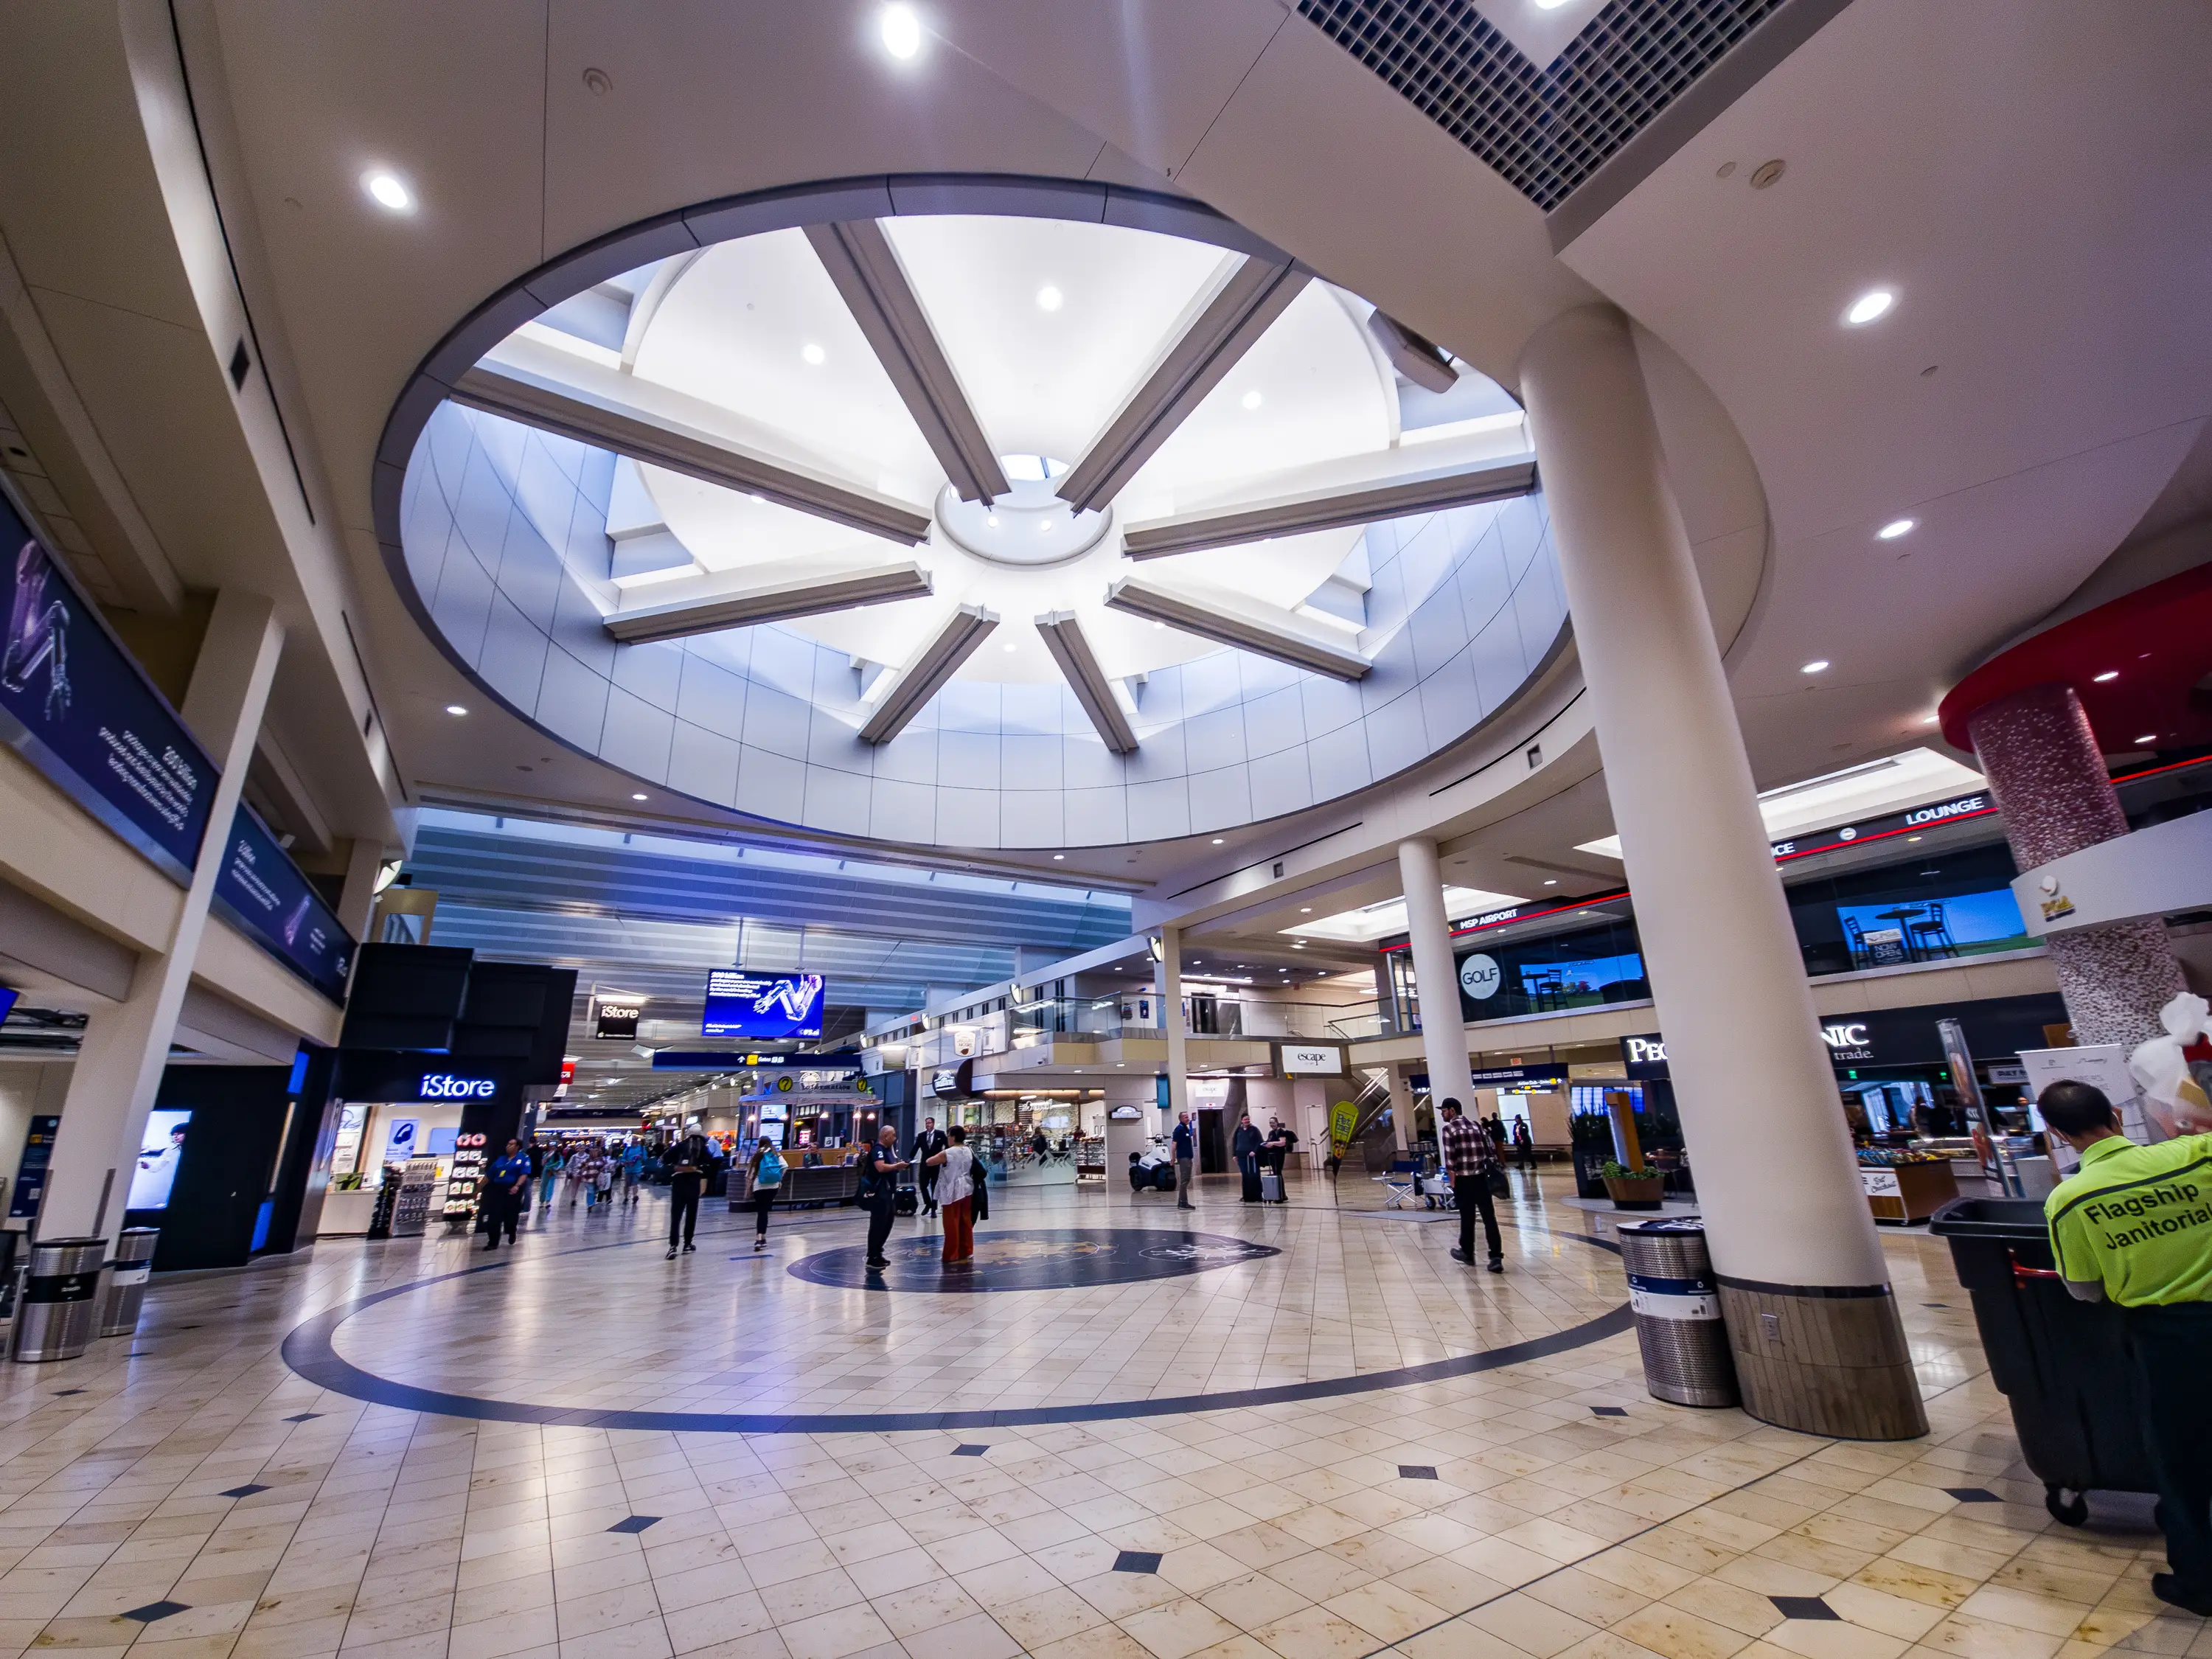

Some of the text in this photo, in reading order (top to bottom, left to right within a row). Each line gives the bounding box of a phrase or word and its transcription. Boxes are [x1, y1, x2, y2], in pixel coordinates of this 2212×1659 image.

[1905, 797, 1984, 825] LOUNGE
[1460, 909, 1517, 930] MSP AIRPORT
[1463, 967, 1498, 984] GOLF
[601, 1006, 639, 1018] iStore
[1297, 1052, 1326, 1065] escape
[420, 1074, 495, 1096] iStore
[2083, 1183, 2199, 1225] Flagship
